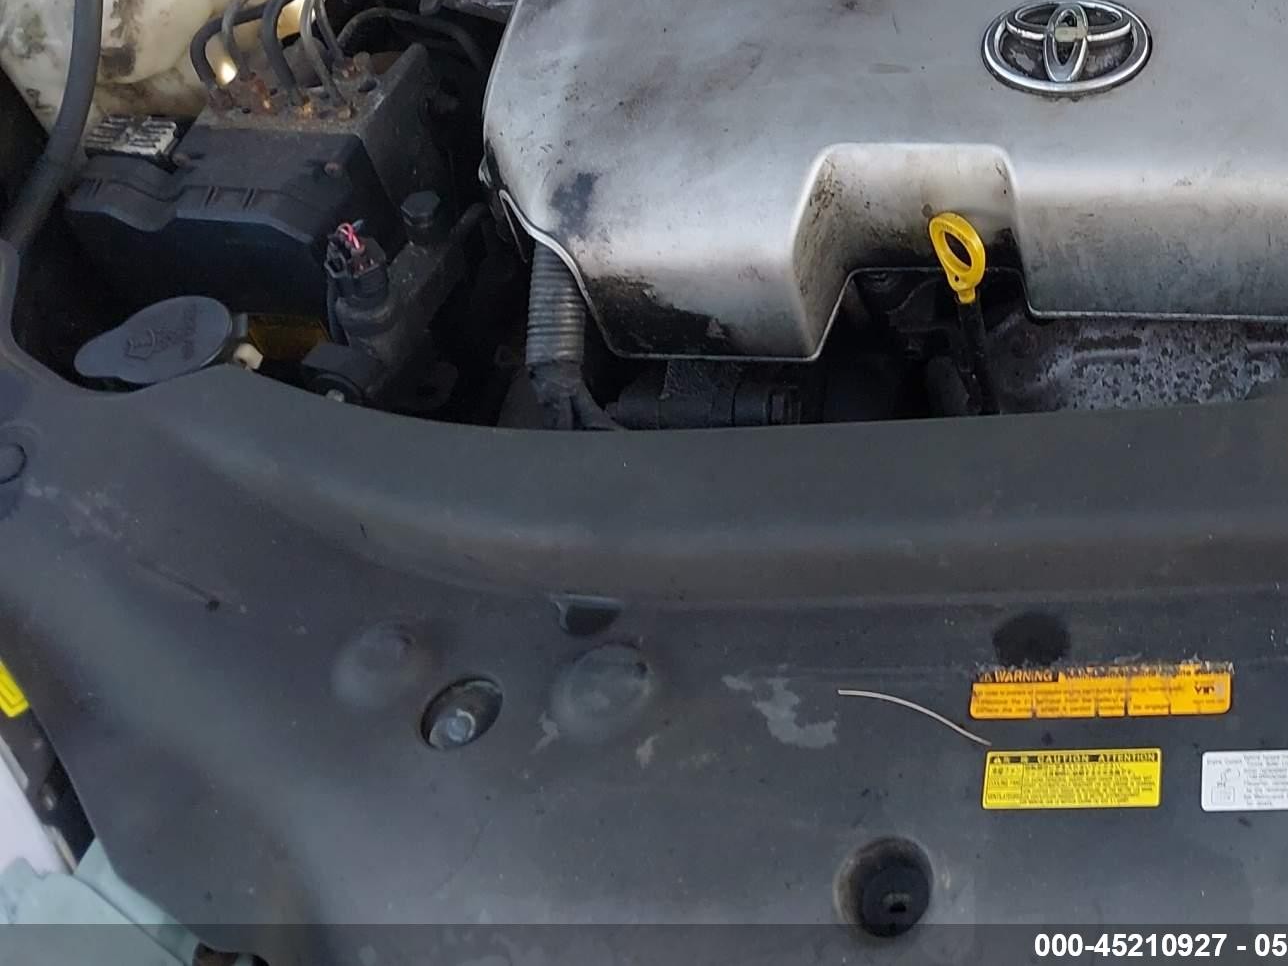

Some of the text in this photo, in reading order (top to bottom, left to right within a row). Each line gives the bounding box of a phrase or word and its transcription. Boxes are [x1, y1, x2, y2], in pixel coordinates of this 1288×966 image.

[994, 667, 1053, 683] WARNING
[1037, 753, 1089, 764] CAUTION
[1099, 752, 1157, 763] ATTENTION
